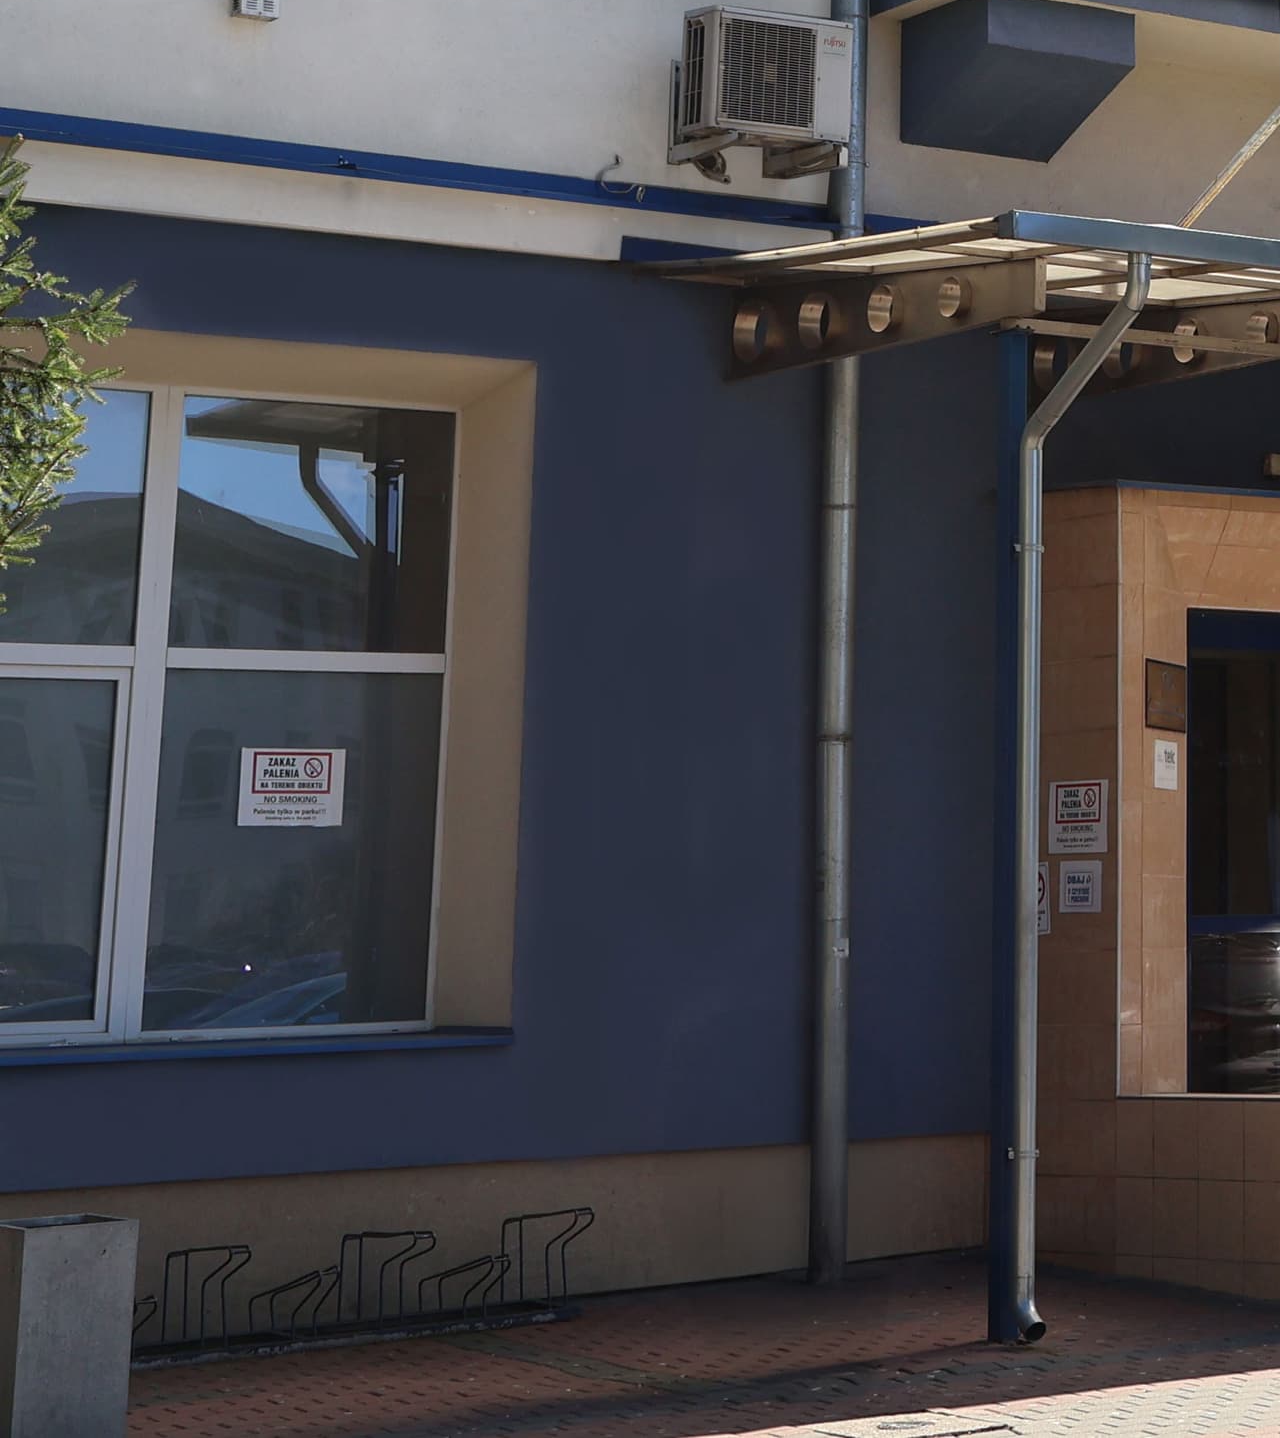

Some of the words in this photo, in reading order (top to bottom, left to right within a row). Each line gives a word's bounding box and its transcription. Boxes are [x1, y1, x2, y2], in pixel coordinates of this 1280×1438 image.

[268, 757, 297, 767] ZAKAZ
[263, 769, 300, 778] PALENIA
[263, 795, 277, 803] NO
[278, 795, 318, 803] SMOKING
